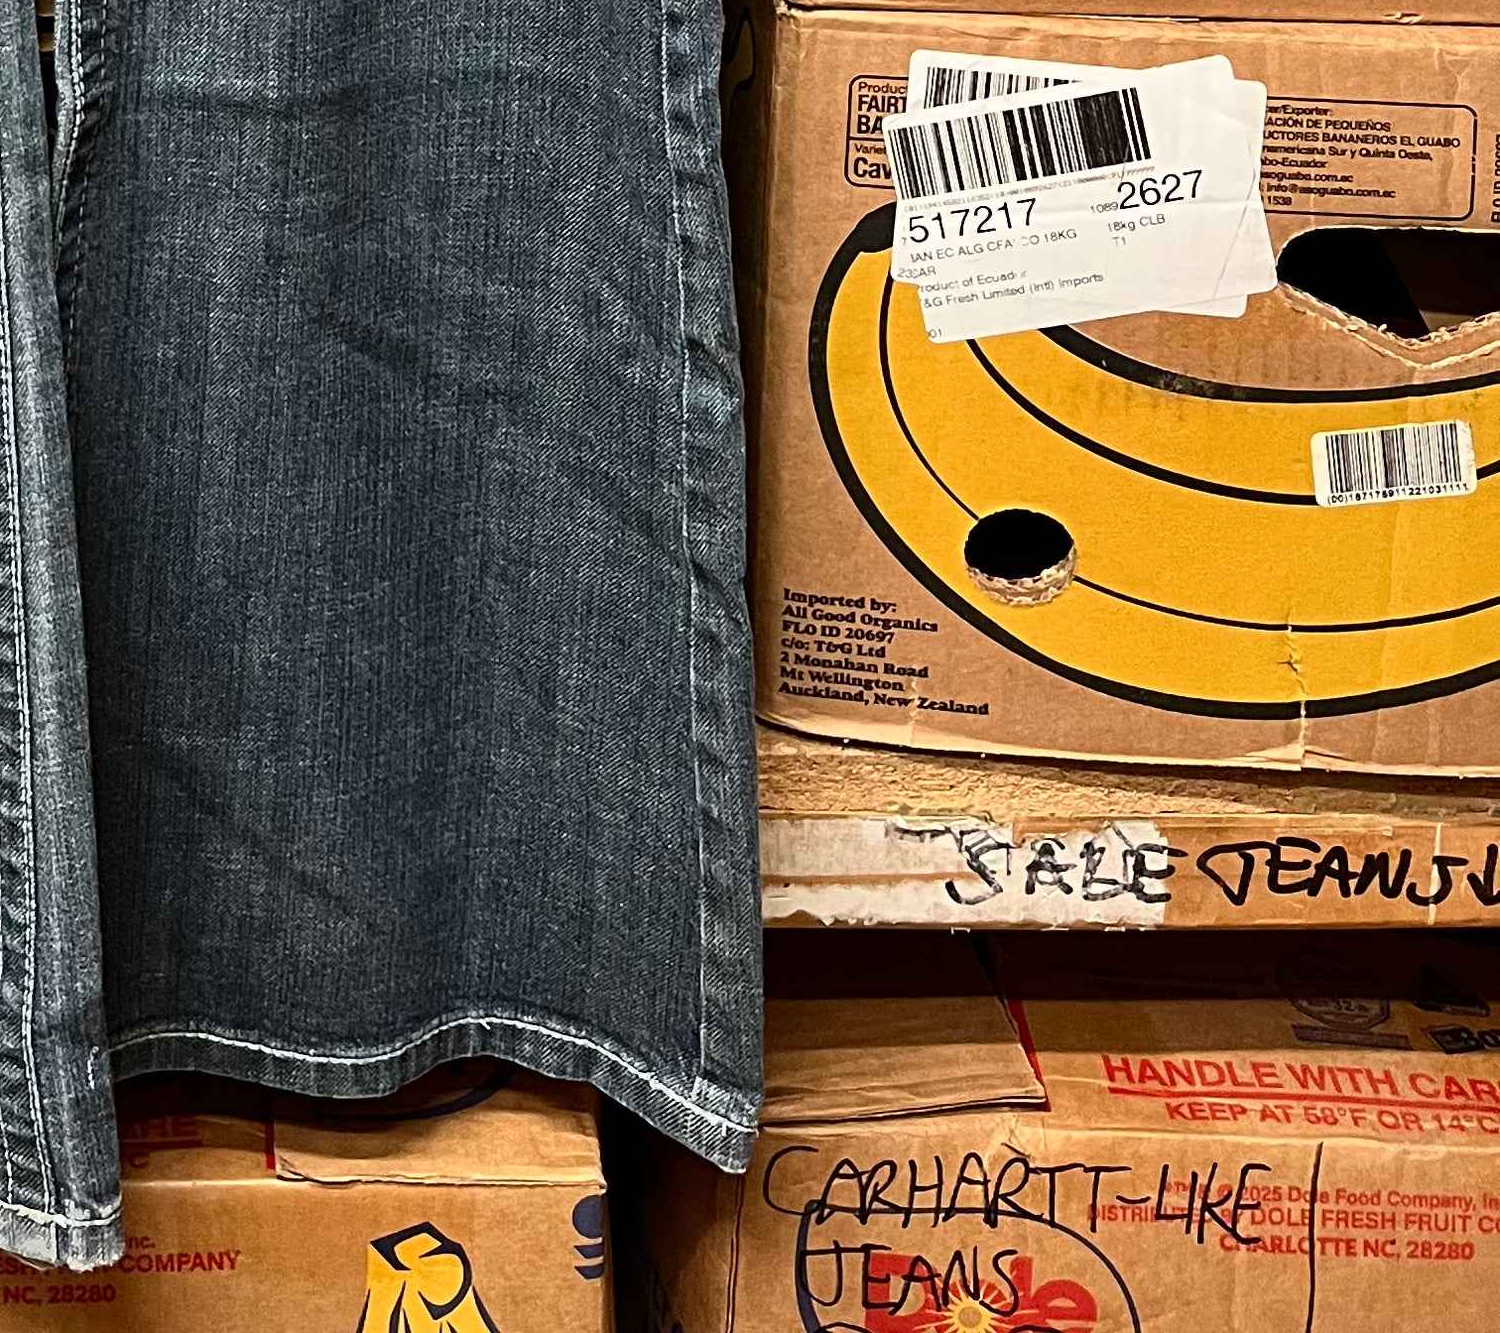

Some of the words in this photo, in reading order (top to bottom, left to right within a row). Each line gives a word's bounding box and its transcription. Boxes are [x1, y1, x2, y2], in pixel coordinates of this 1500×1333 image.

[1322, 133, 1397, 145] BANANEROS
[1117, 169, 1202, 209] 2627
[908, 198, 1036, 244] 517217
[983, 285, 1025, 300] Limited
[783, 588, 865, 609] Imported
[782, 620, 817, 634] FLO
[844, 627, 895, 644] 20697
[812, 608, 856, 623] Good
[860, 613, 938, 632] Organics
[794, 652, 879, 674] Monahan
[883, 662, 929, 678] Road
[808, 669, 904, 692] Wellington
[778, 682, 870, 706] Auckland,
[918, 696, 989, 716] Zealand
[1101, 1052, 1286, 1090] HANDLE
[1285, 1062, 1399, 1097] WITH
[1165, 1100, 1248, 1124] KEEP
[1259, 1103, 1294, 1124] AT
[1378, 1110, 1423, 1133] OR
[1335, 1188, 1382, 1206] Food
[1387, 1190, 1477, 1213] Company,
[1322, 1209, 1396, 1230] FRESH
[1404, 1212, 1472, 1233] FRUIT
[1406, 1240, 1474, 1260] 28280
[47, 1283, 116, 1304] 28280
